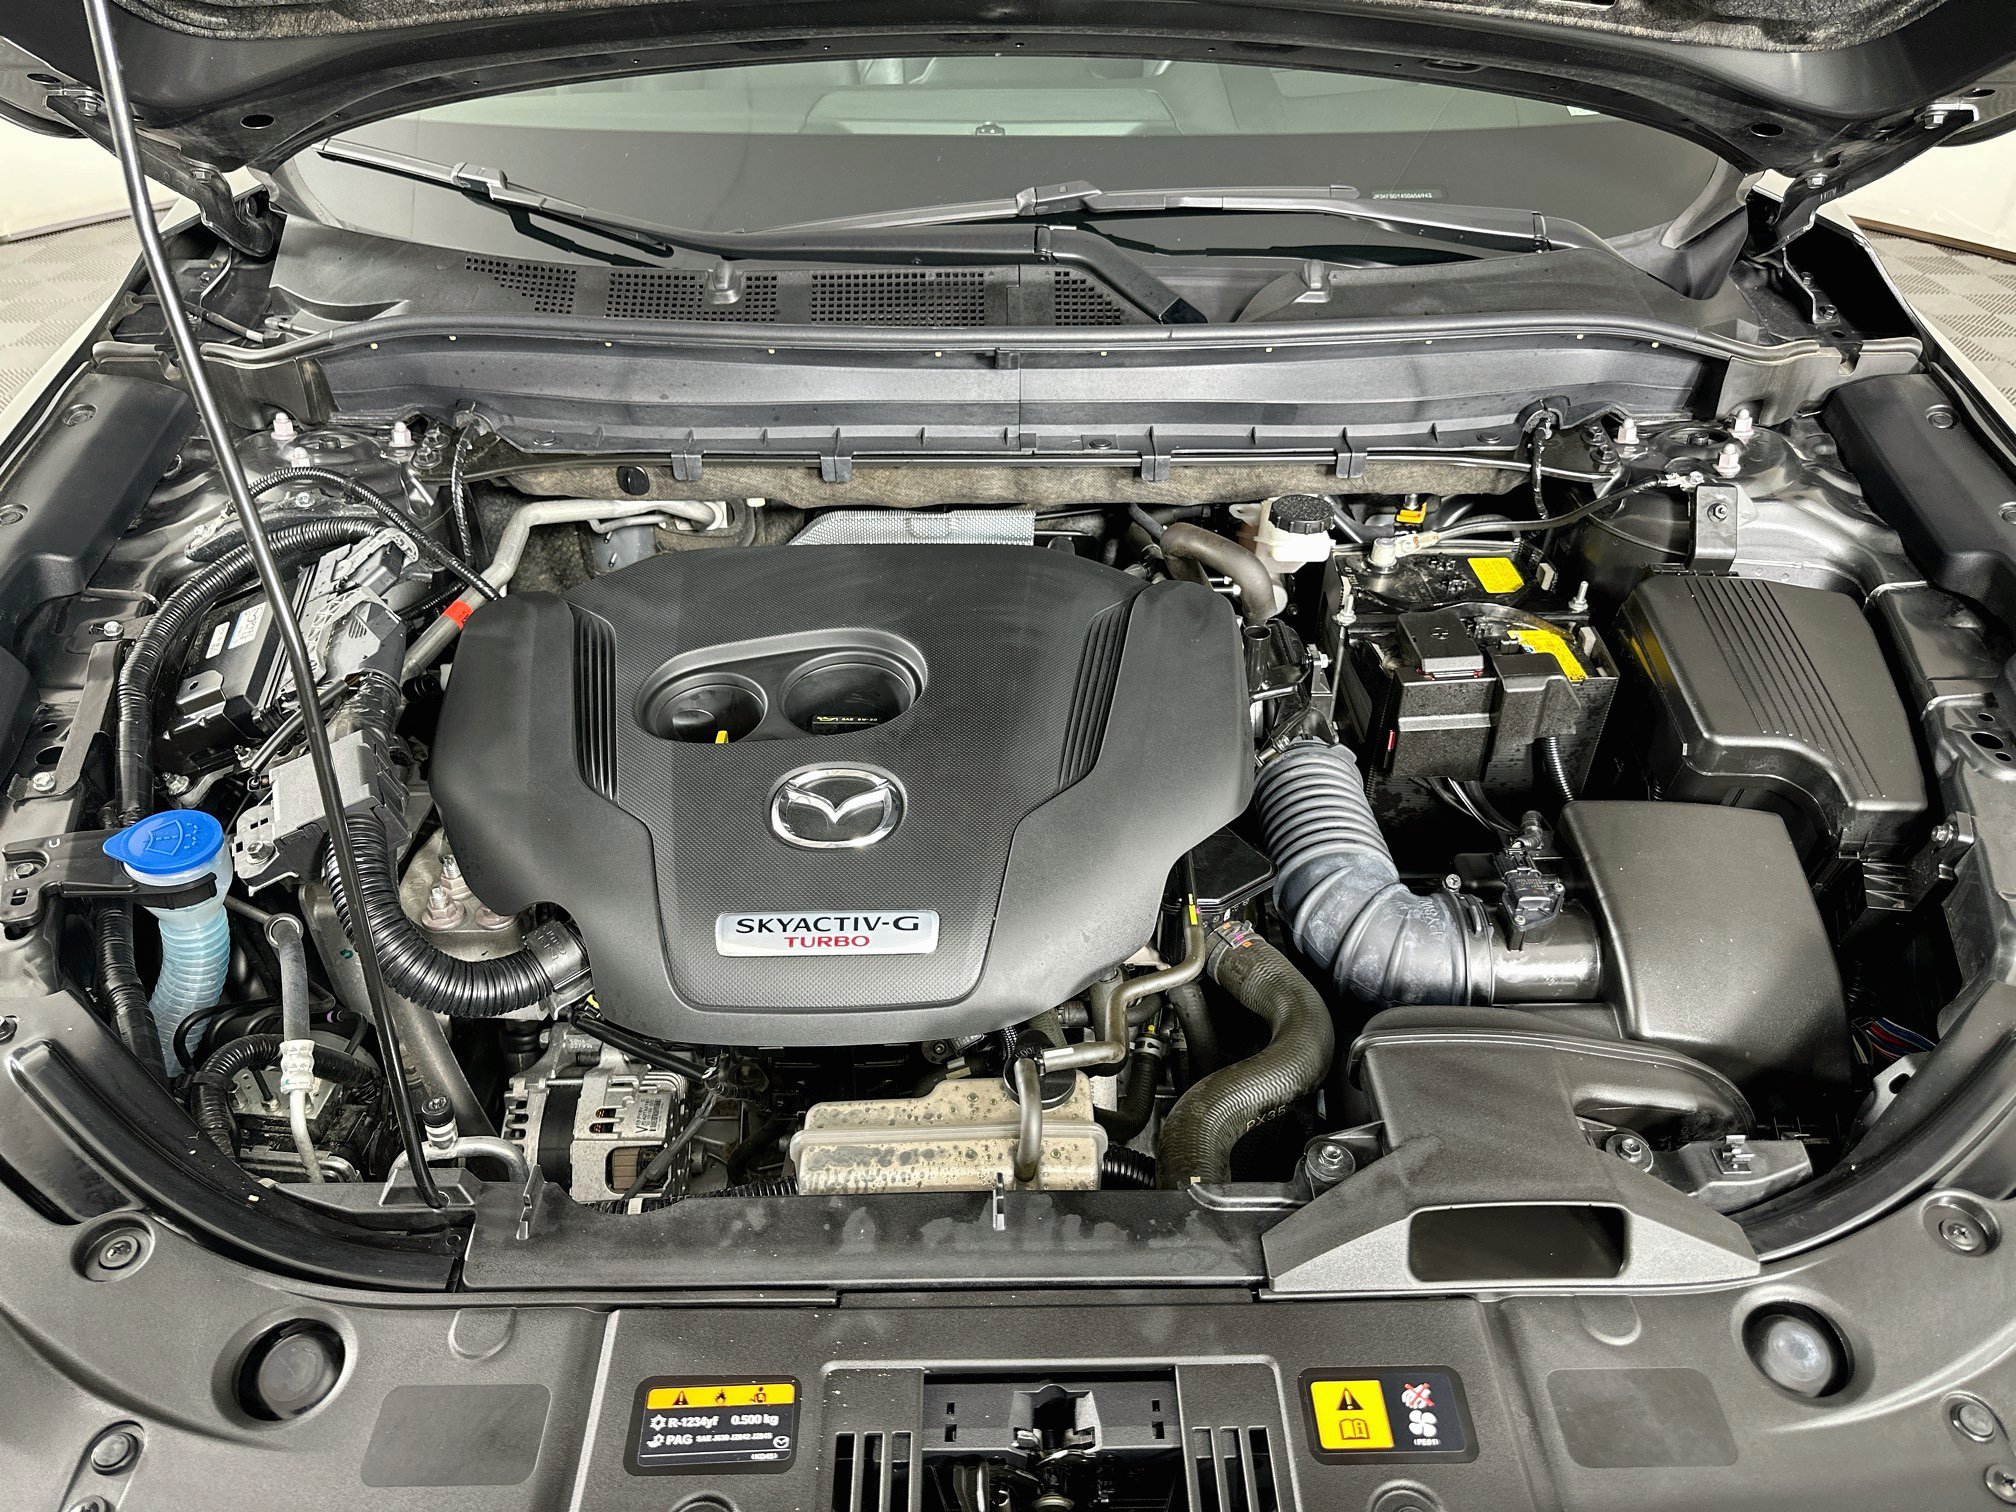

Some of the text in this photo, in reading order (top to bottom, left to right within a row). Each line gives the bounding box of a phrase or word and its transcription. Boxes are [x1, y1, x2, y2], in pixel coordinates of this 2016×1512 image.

[736, 916, 919, 933] SKYACTIV-G
[784, 935, 870, 948] TURBO
[668, 1413, 779, 1428] R-1234yf 0.500 kg
[666, 1434, 693, 1445] PAG
